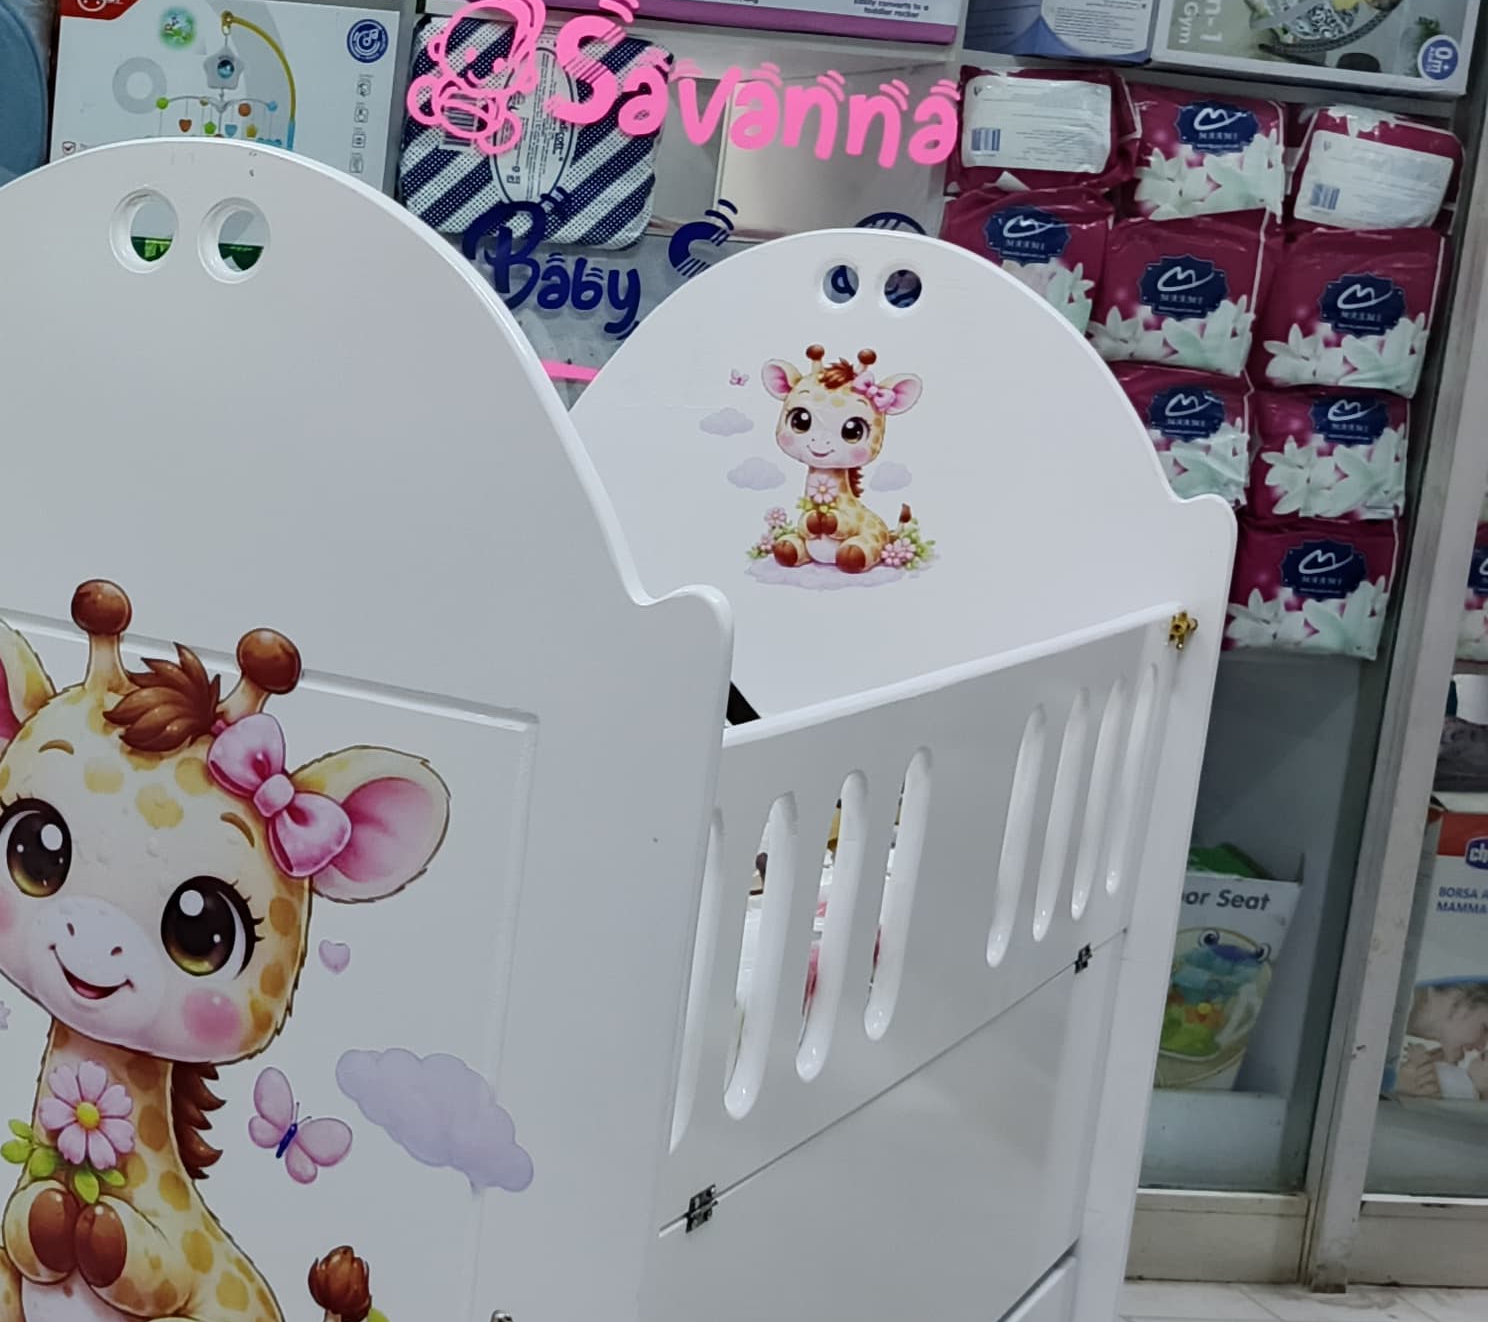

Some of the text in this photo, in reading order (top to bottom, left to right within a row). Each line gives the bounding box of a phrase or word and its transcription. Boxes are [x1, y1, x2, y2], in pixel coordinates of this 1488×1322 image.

[1177, 0, 1200, 45] Gym
[548, 13, 960, 169] Savanna
[462, 199, 642, 340] Baby
[1216, 889, 1270, 911] Seat
[1438, 886, 1479, 899] BORSA
